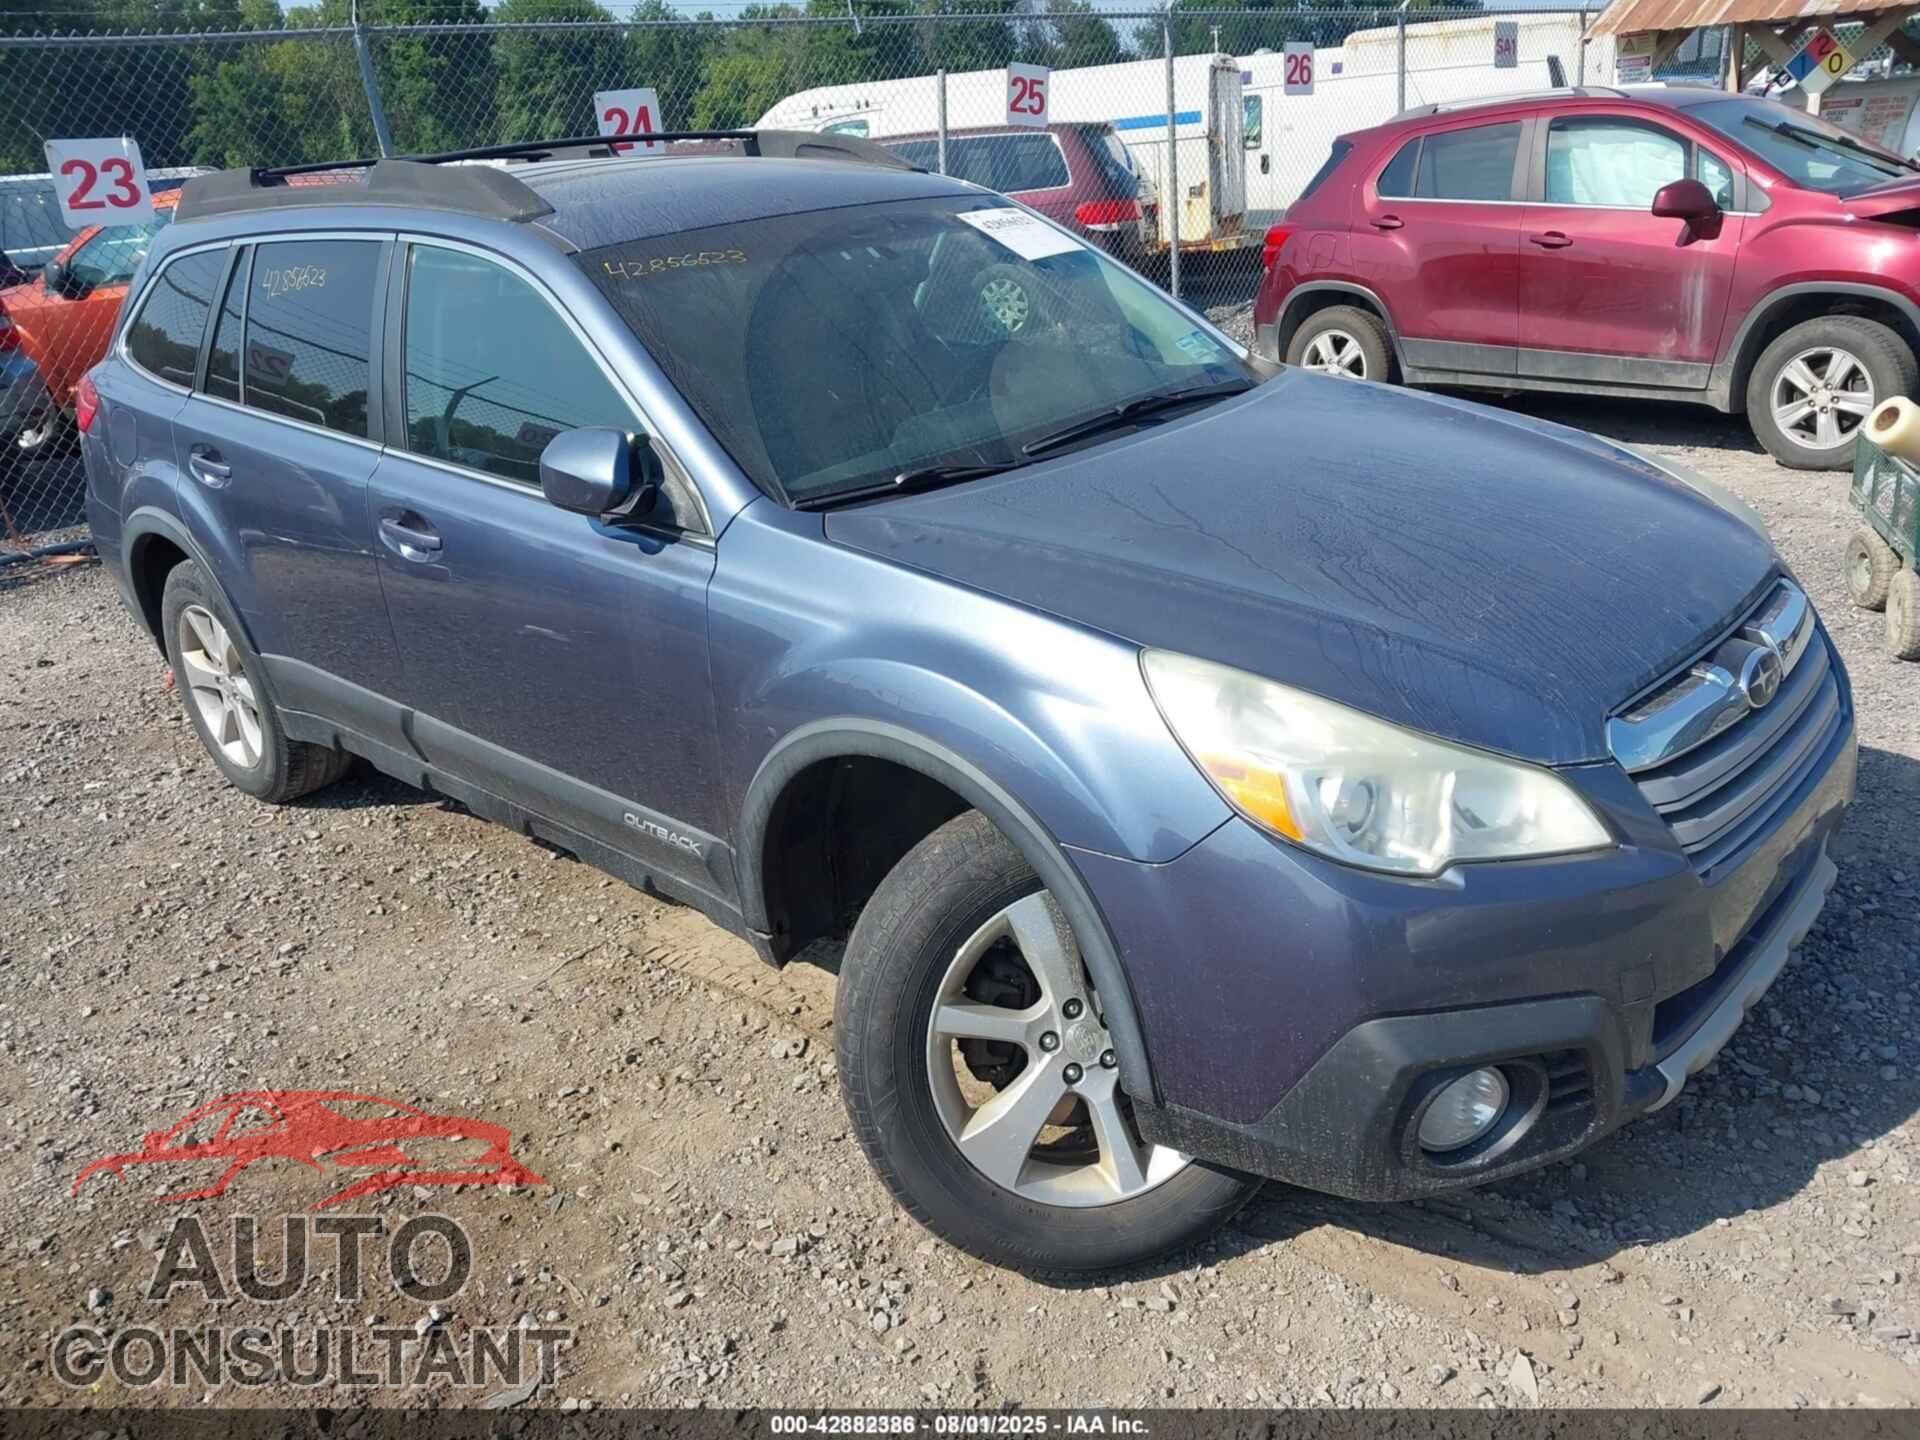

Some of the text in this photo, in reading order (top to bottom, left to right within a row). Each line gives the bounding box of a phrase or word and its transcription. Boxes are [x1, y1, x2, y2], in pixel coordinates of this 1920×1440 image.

[1817, 34, 1833, 55] 2
[1828, 52, 1843, 73] 0
[1287, 54, 1312, 85] 26
[1010, 76, 1045, 115] 25
[603, 105, 655, 151] 24
[61, 158, 141, 209] 23
[623, 812, 703, 858] OUTBACK
